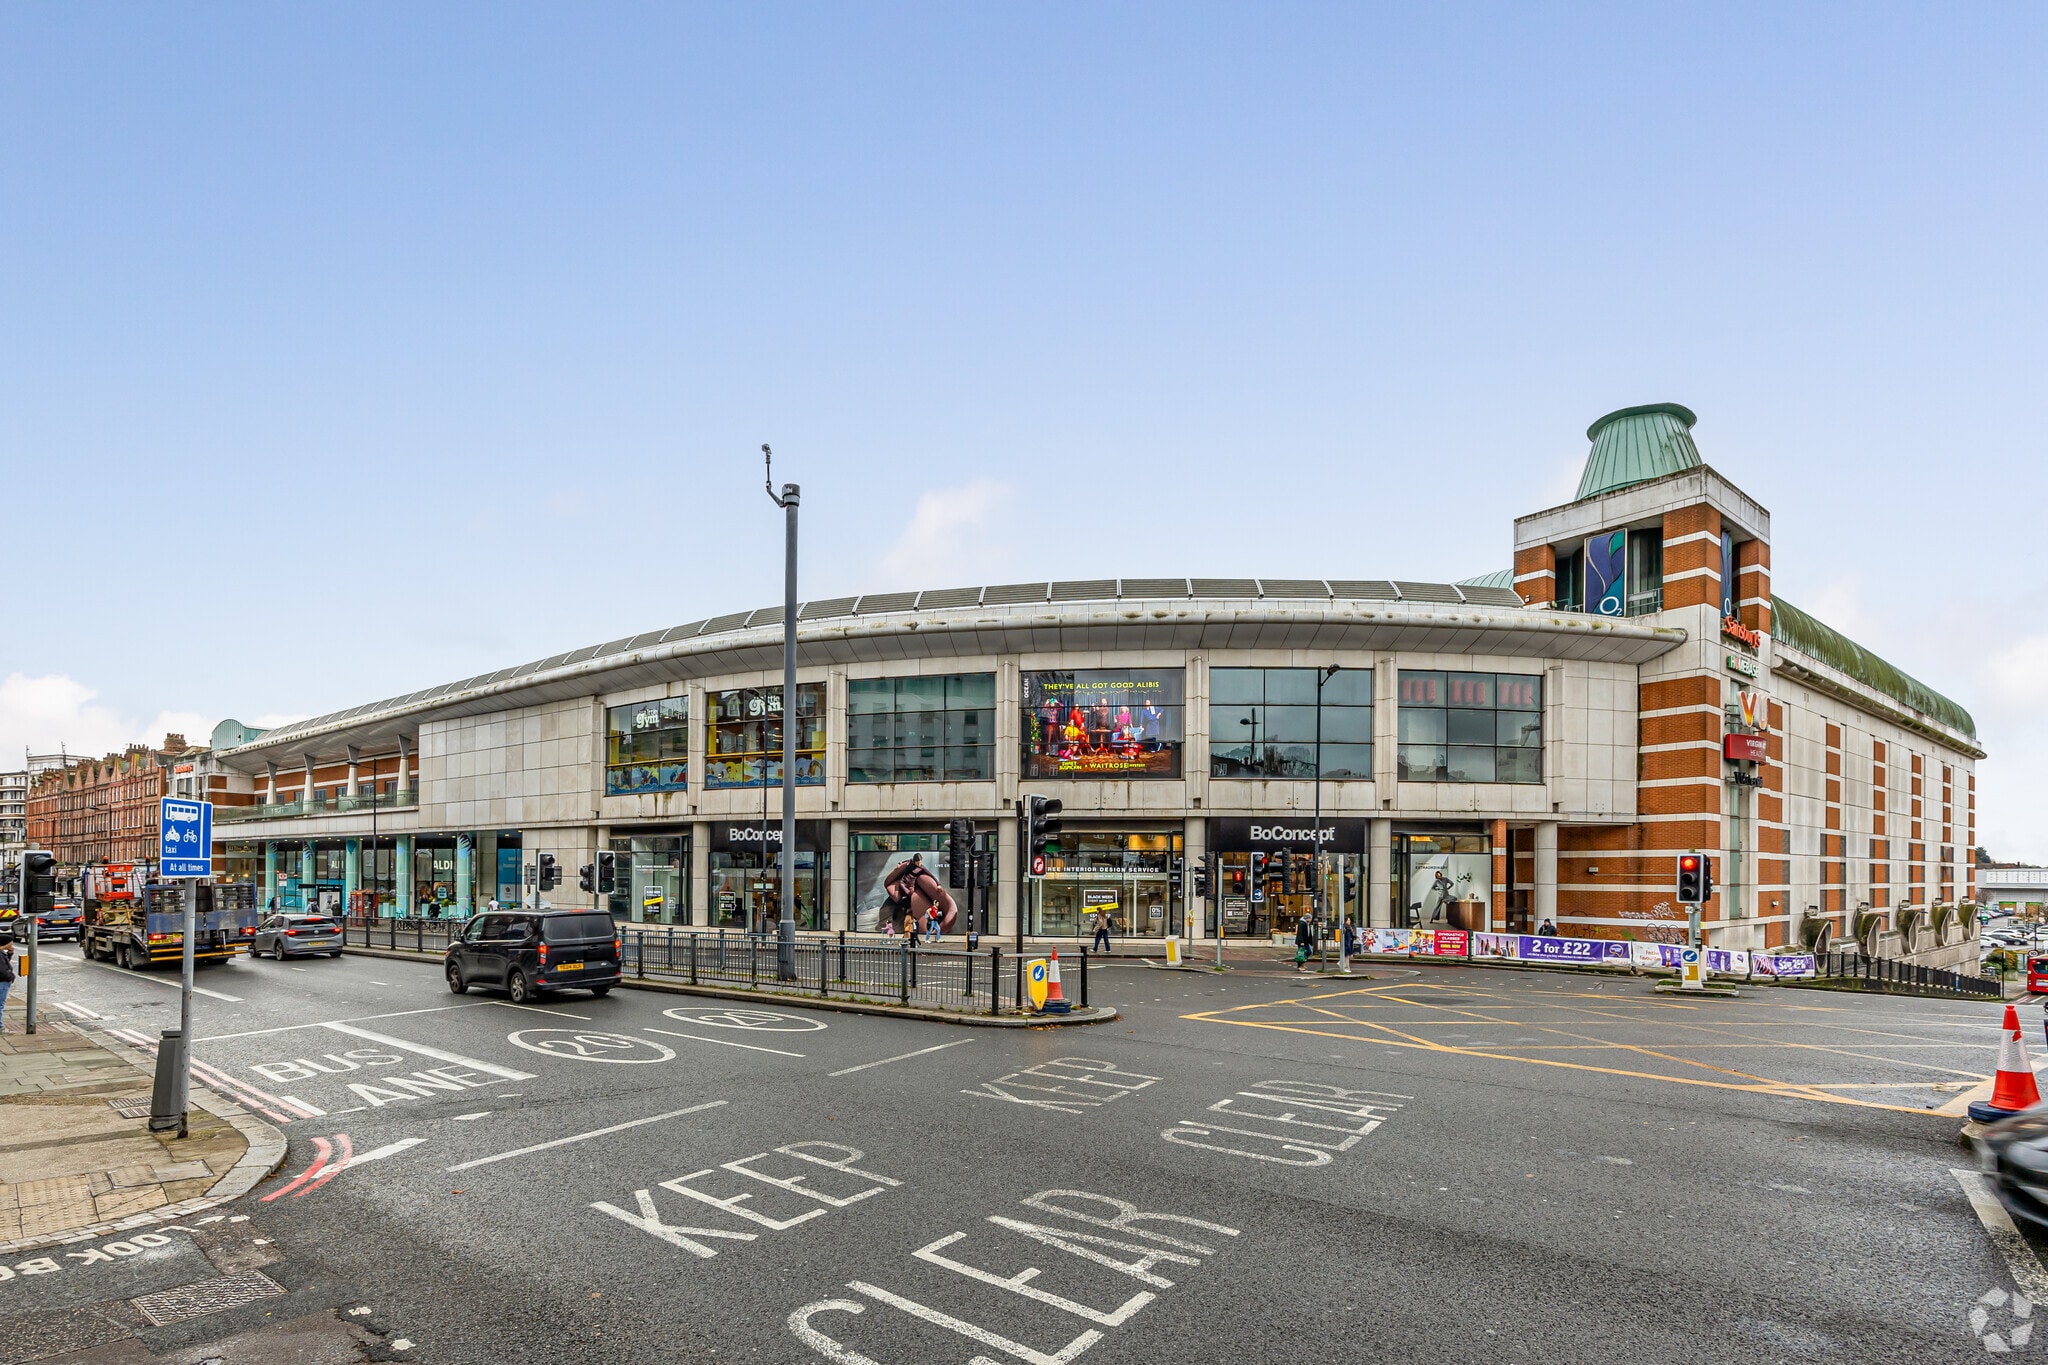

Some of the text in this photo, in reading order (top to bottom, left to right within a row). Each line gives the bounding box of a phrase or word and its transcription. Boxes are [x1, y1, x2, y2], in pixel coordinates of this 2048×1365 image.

[1250, 825, 1335, 844] BoConcept
[165, 845, 177, 854] taxi
[169, 863, 204, 872] At all times
[433, 860, 453, 870] ALDI
[1532, 939, 1591, 956] 2 for £22
[699, 1011, 783, 1026] 20
[538, 1035, 635, 1056] 20
[250, 1048, 404, 1083] BUS
[961, 1057, 1164, 1114] KEEP
[1160, 1080, 1415, 1167] CLEAR
[591, 1140, 904, 1259] KEEP
[66, 1225, 200, 1265] LOOK
